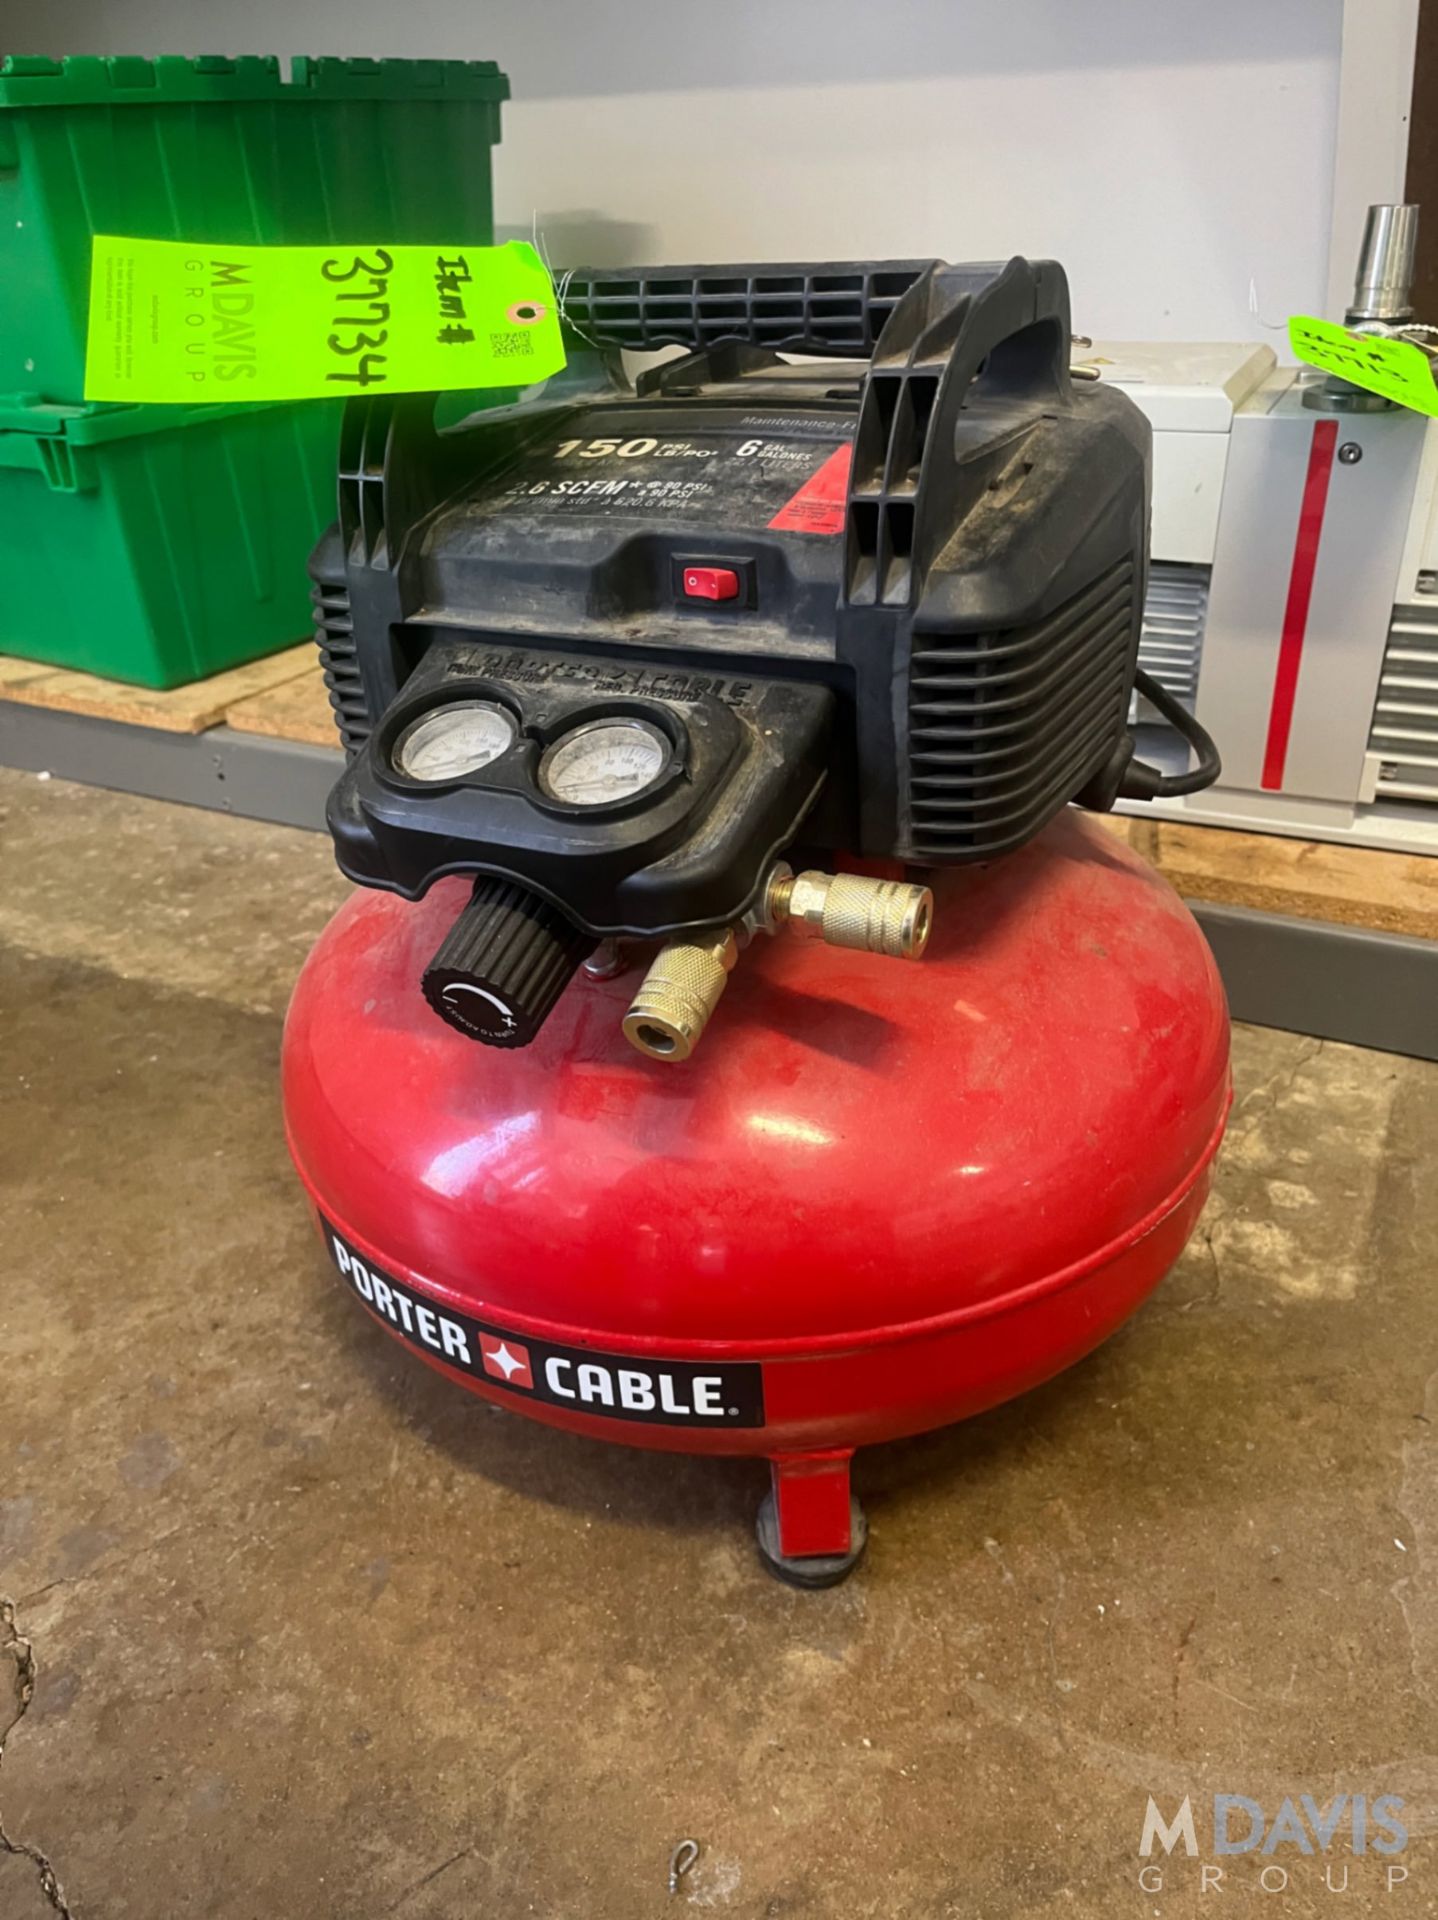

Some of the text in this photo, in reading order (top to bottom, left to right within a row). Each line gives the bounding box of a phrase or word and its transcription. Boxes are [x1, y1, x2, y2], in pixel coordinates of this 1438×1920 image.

[184, 259, 206, 382] GROUP
[321, 248, 394, 387] 37734
[434, 255, 475, 345] Item #
[553, 438, 658, 458] 150
[736, 439, 786, 457] 6 GAL
[668, 489, 694, 499] PSI
[682, 482, 709, 491] PSI
[333, 1235, 472, 1365] PORTER
